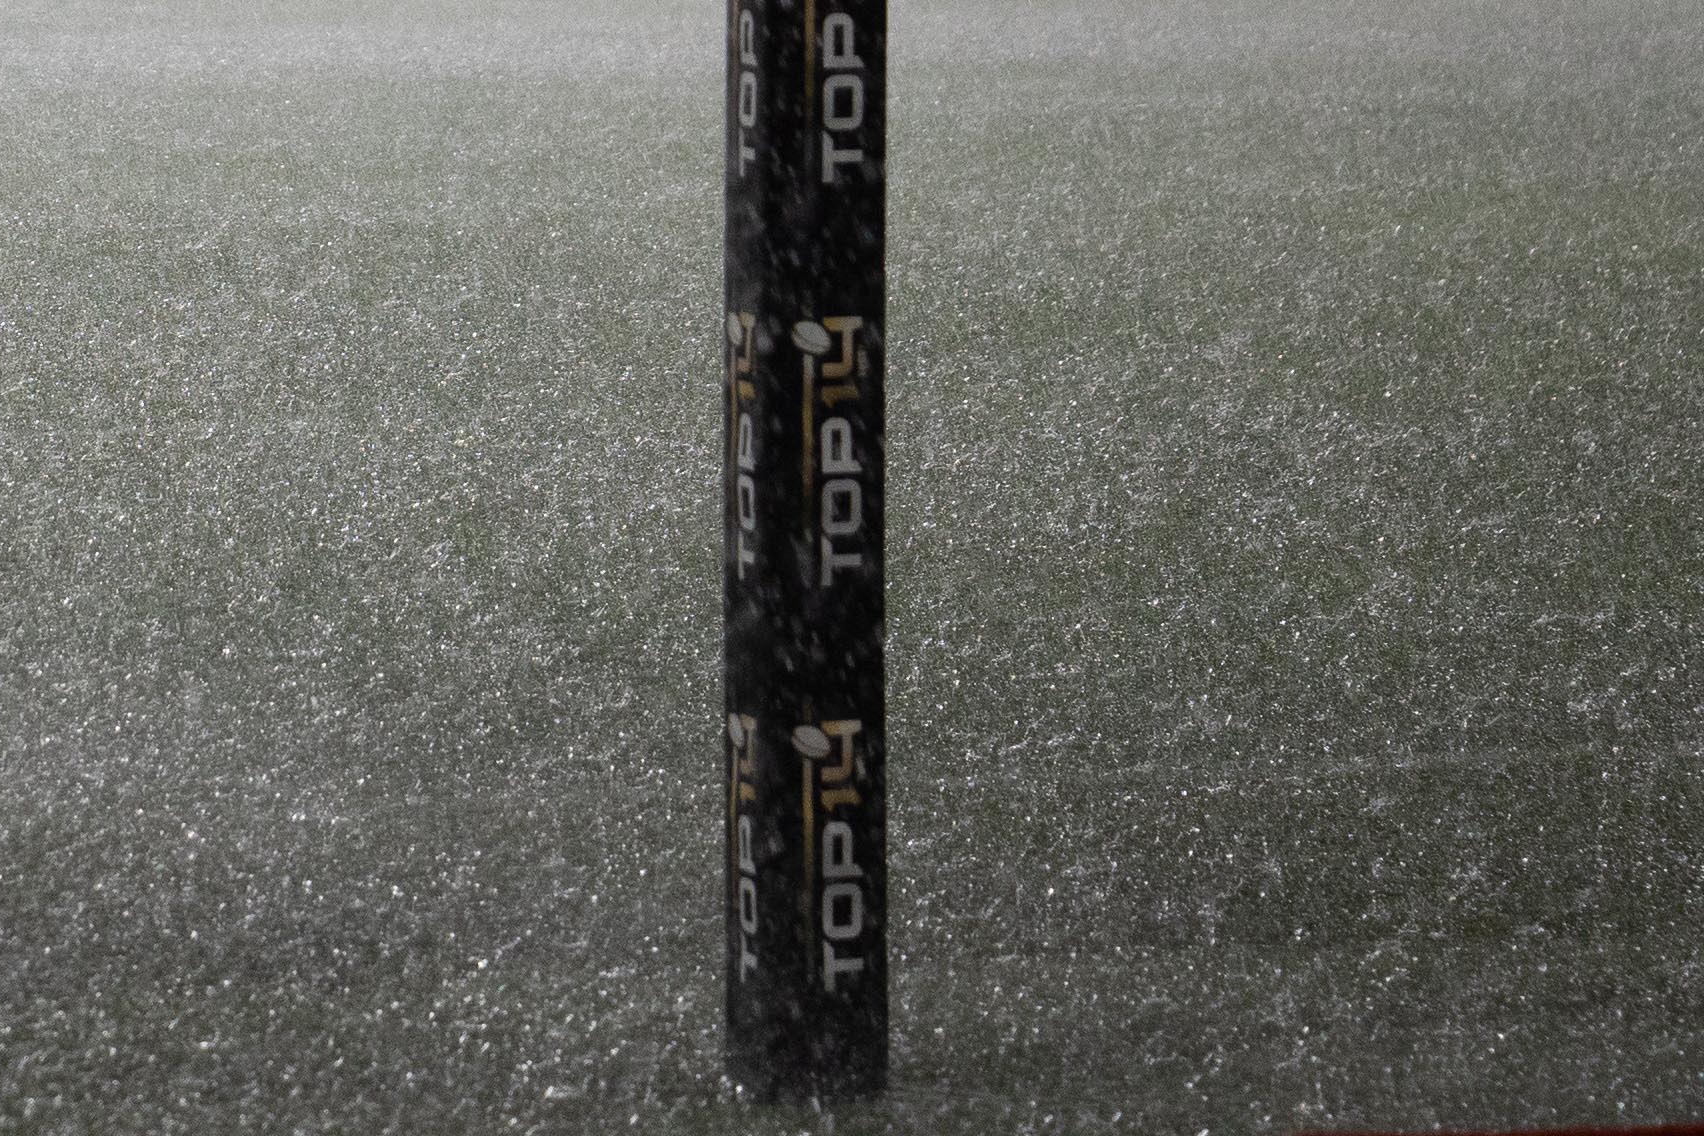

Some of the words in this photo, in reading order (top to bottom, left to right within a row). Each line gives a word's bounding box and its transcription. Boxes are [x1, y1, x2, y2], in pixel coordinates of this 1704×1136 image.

[821, 12, 865, 184] TOP
[819, 416, 863, 586] TOP
[821, 821, 865, 993] TOP
